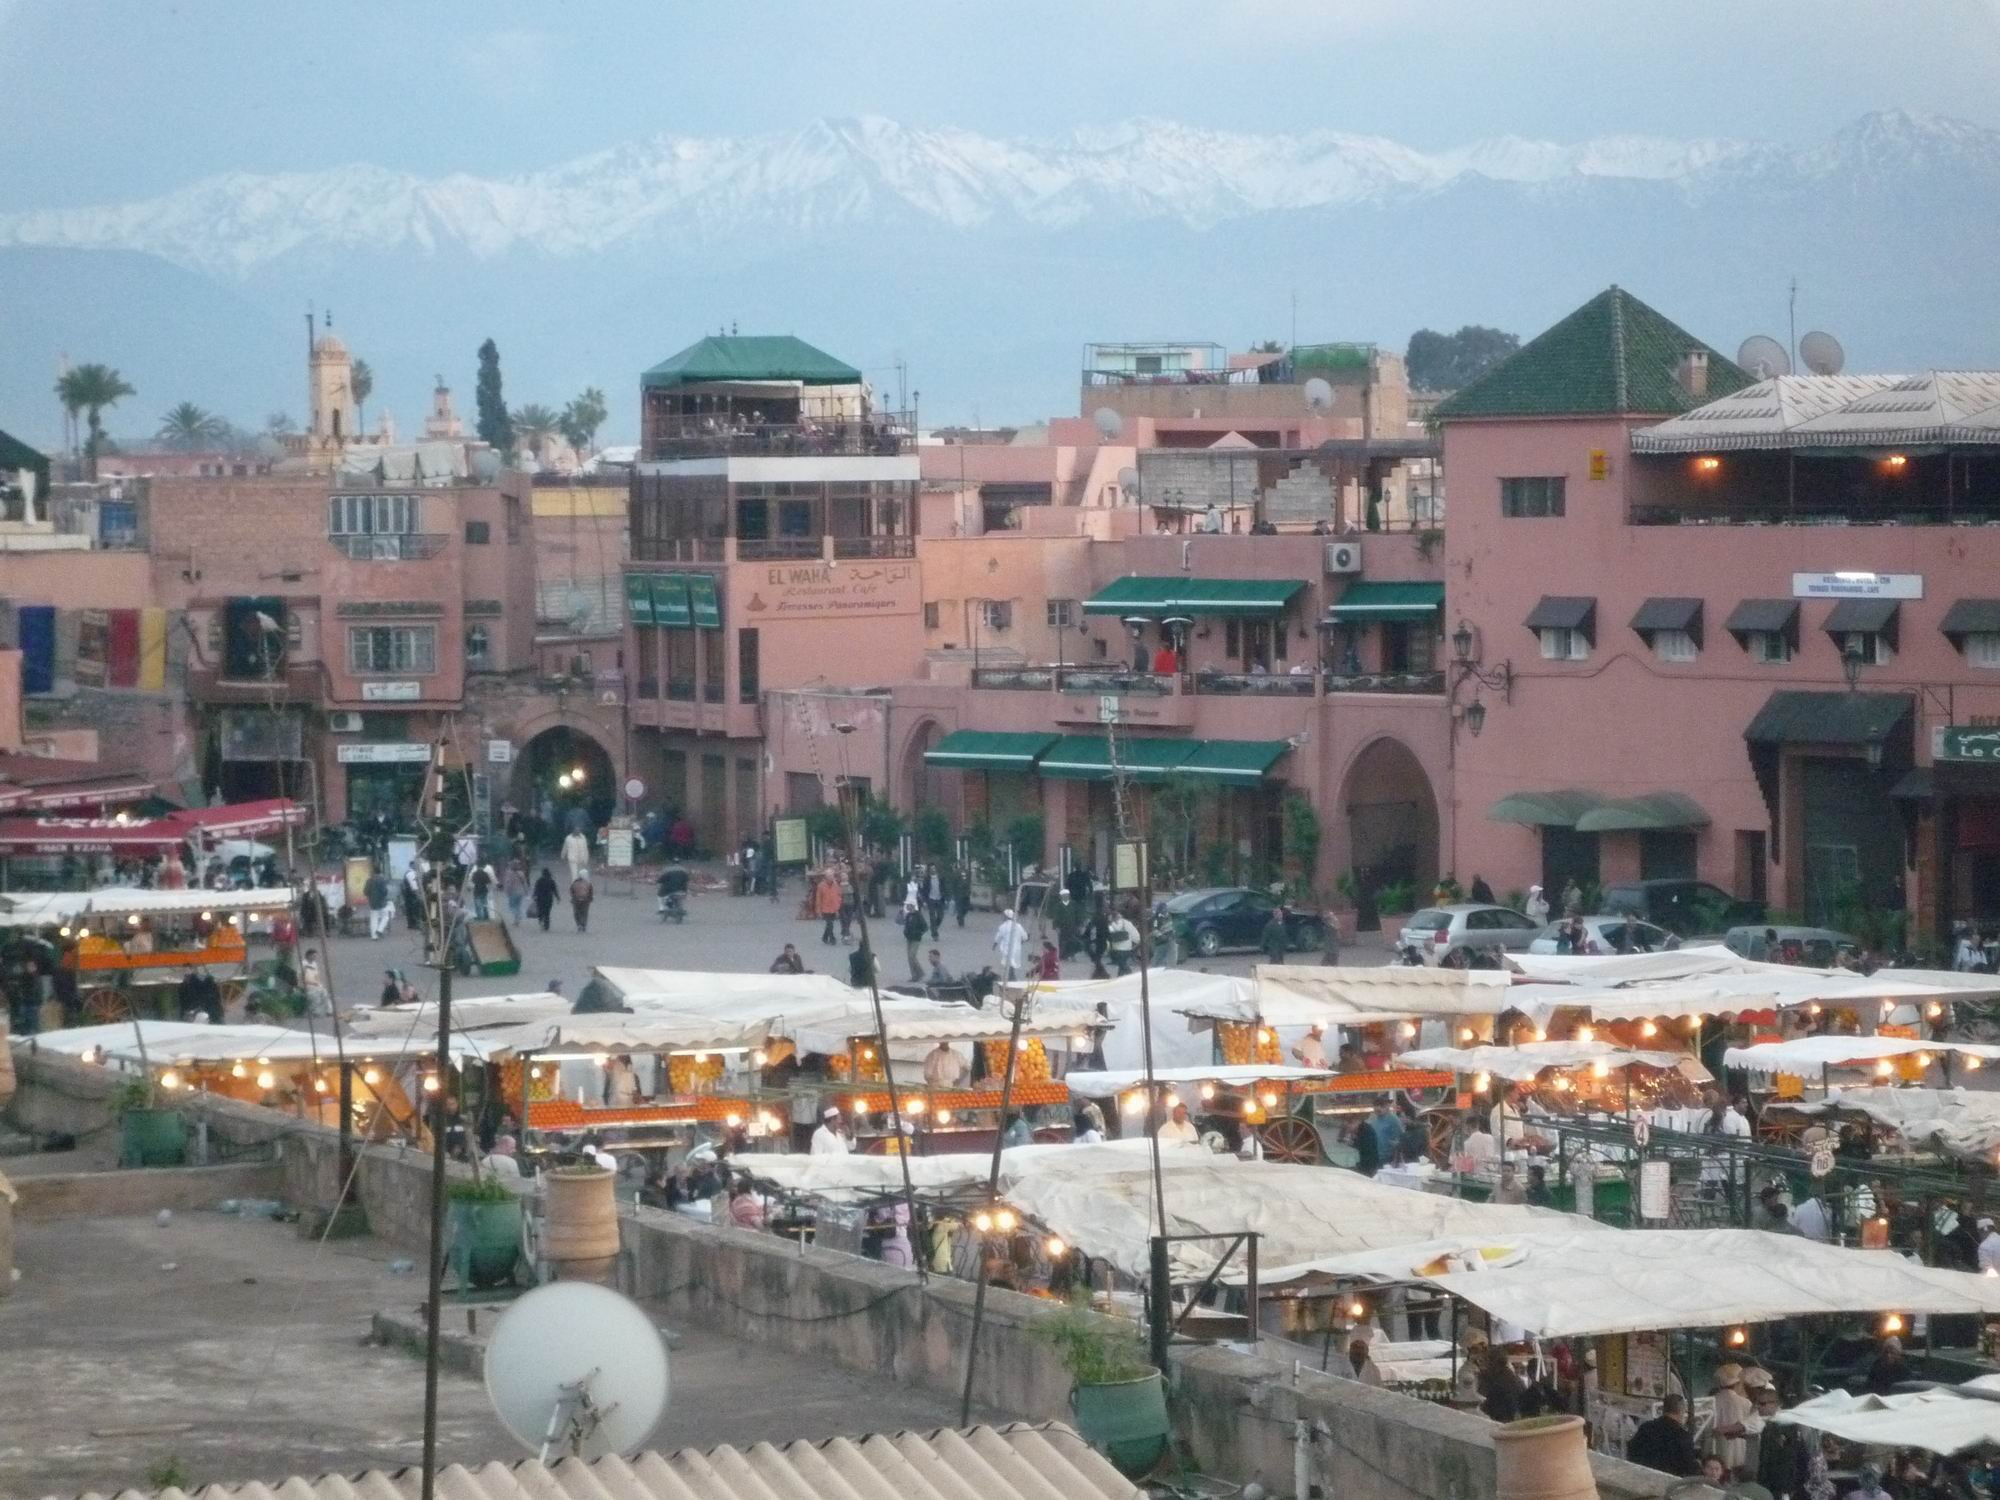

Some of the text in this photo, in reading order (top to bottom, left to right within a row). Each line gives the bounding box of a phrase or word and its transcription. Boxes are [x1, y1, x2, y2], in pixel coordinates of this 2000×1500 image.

[768, 568, 831, 585] EL WAHA
[1961, 746, 1984, 757] Le
